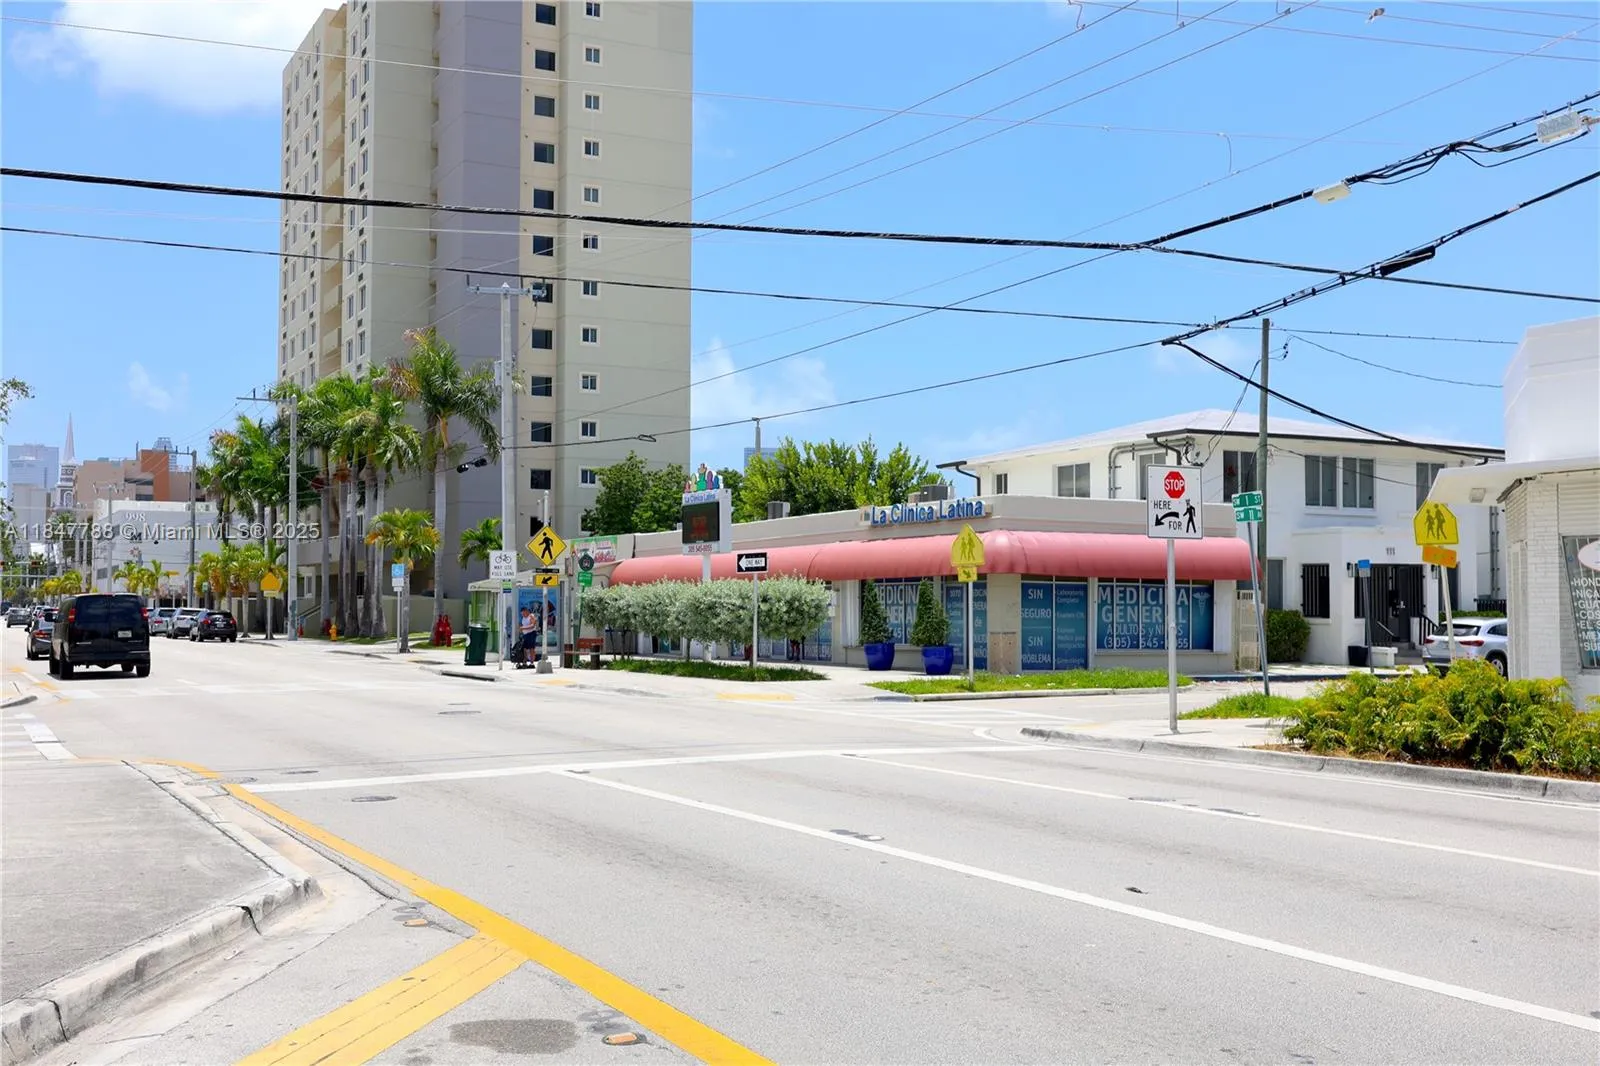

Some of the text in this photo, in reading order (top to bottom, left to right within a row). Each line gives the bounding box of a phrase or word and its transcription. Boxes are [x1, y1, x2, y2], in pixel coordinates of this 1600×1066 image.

[1164, 480, 1186, 491] STOP
[1153, 499, 1172, 510] HERE
[125, 511, 146, 522] 998
[872, 506, 887, 526] La
[939, 498, 984, 519] Latina
[1168, 520, 1182, 531] FOR
[1028, 588, 1044, 600] SIN
[1098, 586, 1189, 606] MEDICIA
[1020, 608, 1052, 619] SEGURO
[1102, 605, 1187, 624] GENERL
[1155, 624, 1184, 637] NIS
[1580, 620, 1594, 630] EL
[1028, 636, 1044, 648] SIN
